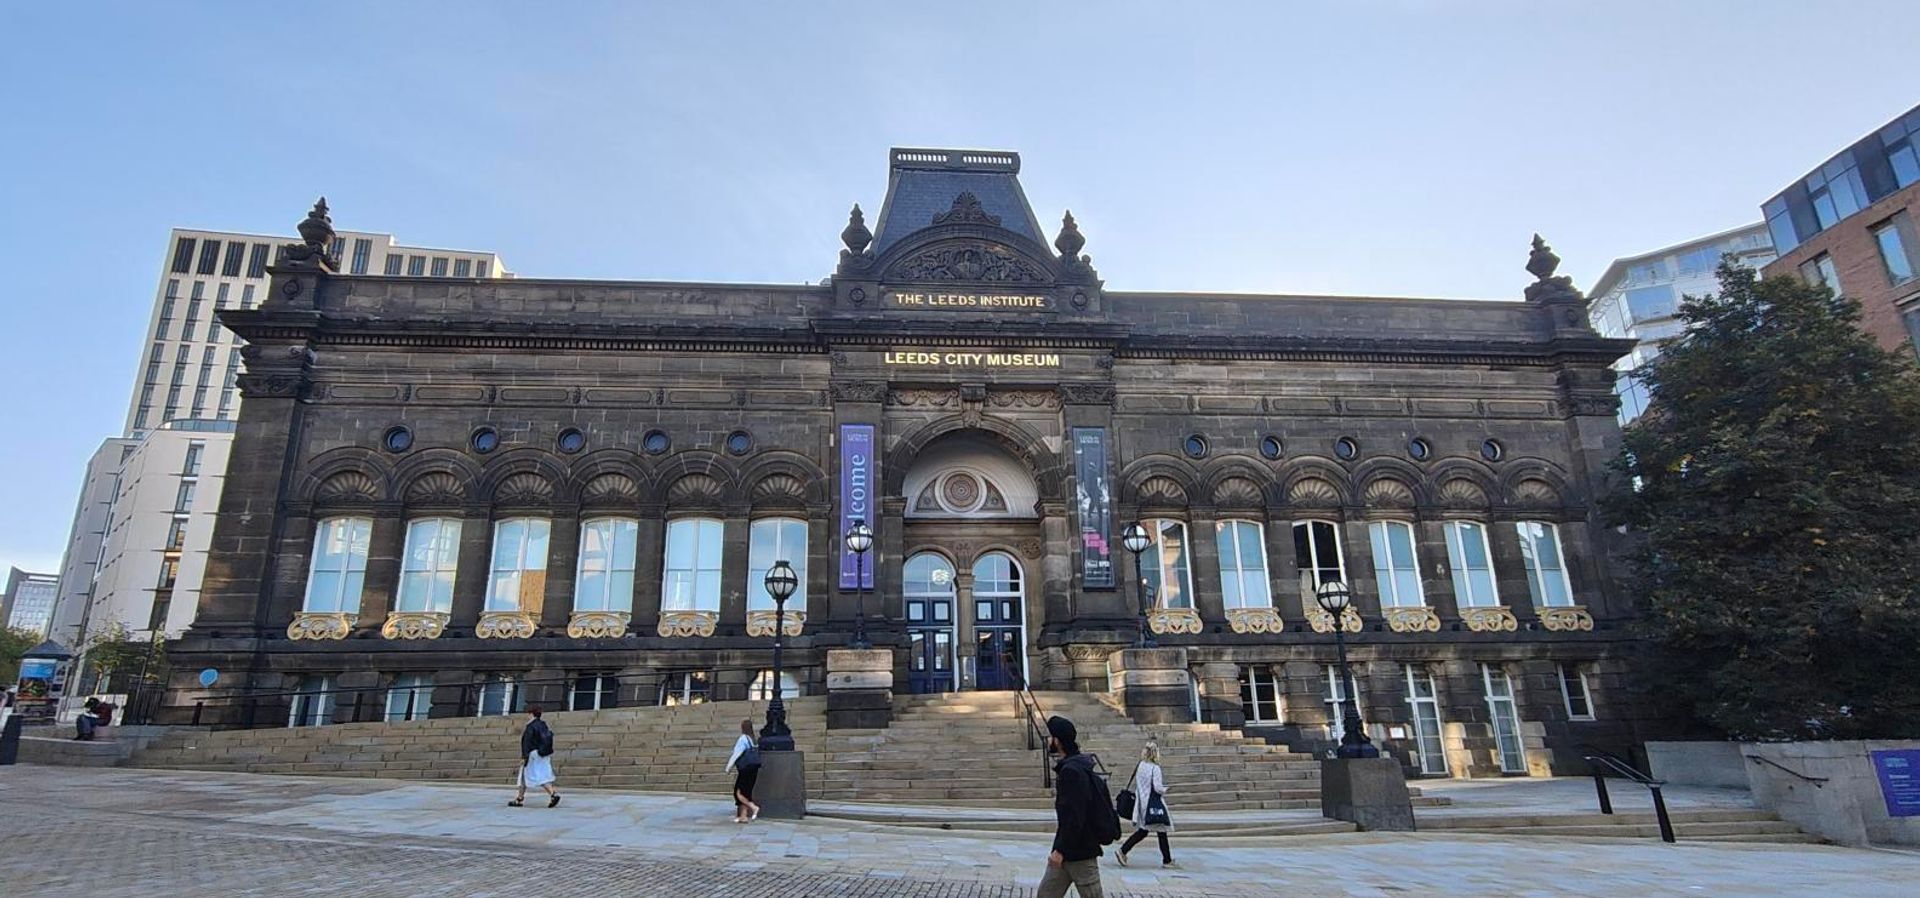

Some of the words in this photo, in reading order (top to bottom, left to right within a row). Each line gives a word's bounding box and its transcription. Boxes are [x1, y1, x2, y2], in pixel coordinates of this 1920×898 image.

[896, 294, 924, 305] THE
[928, 295, 976, 306] LEEDS
[980, 295, 1045, 307] INSTITUTE
[885, 352, 940, 365] LEEDS
[944, 353, 983, 366] CITY
[986, 353, 1060, 366] MUSEUM
[847, 454, 865, 555] lcome
